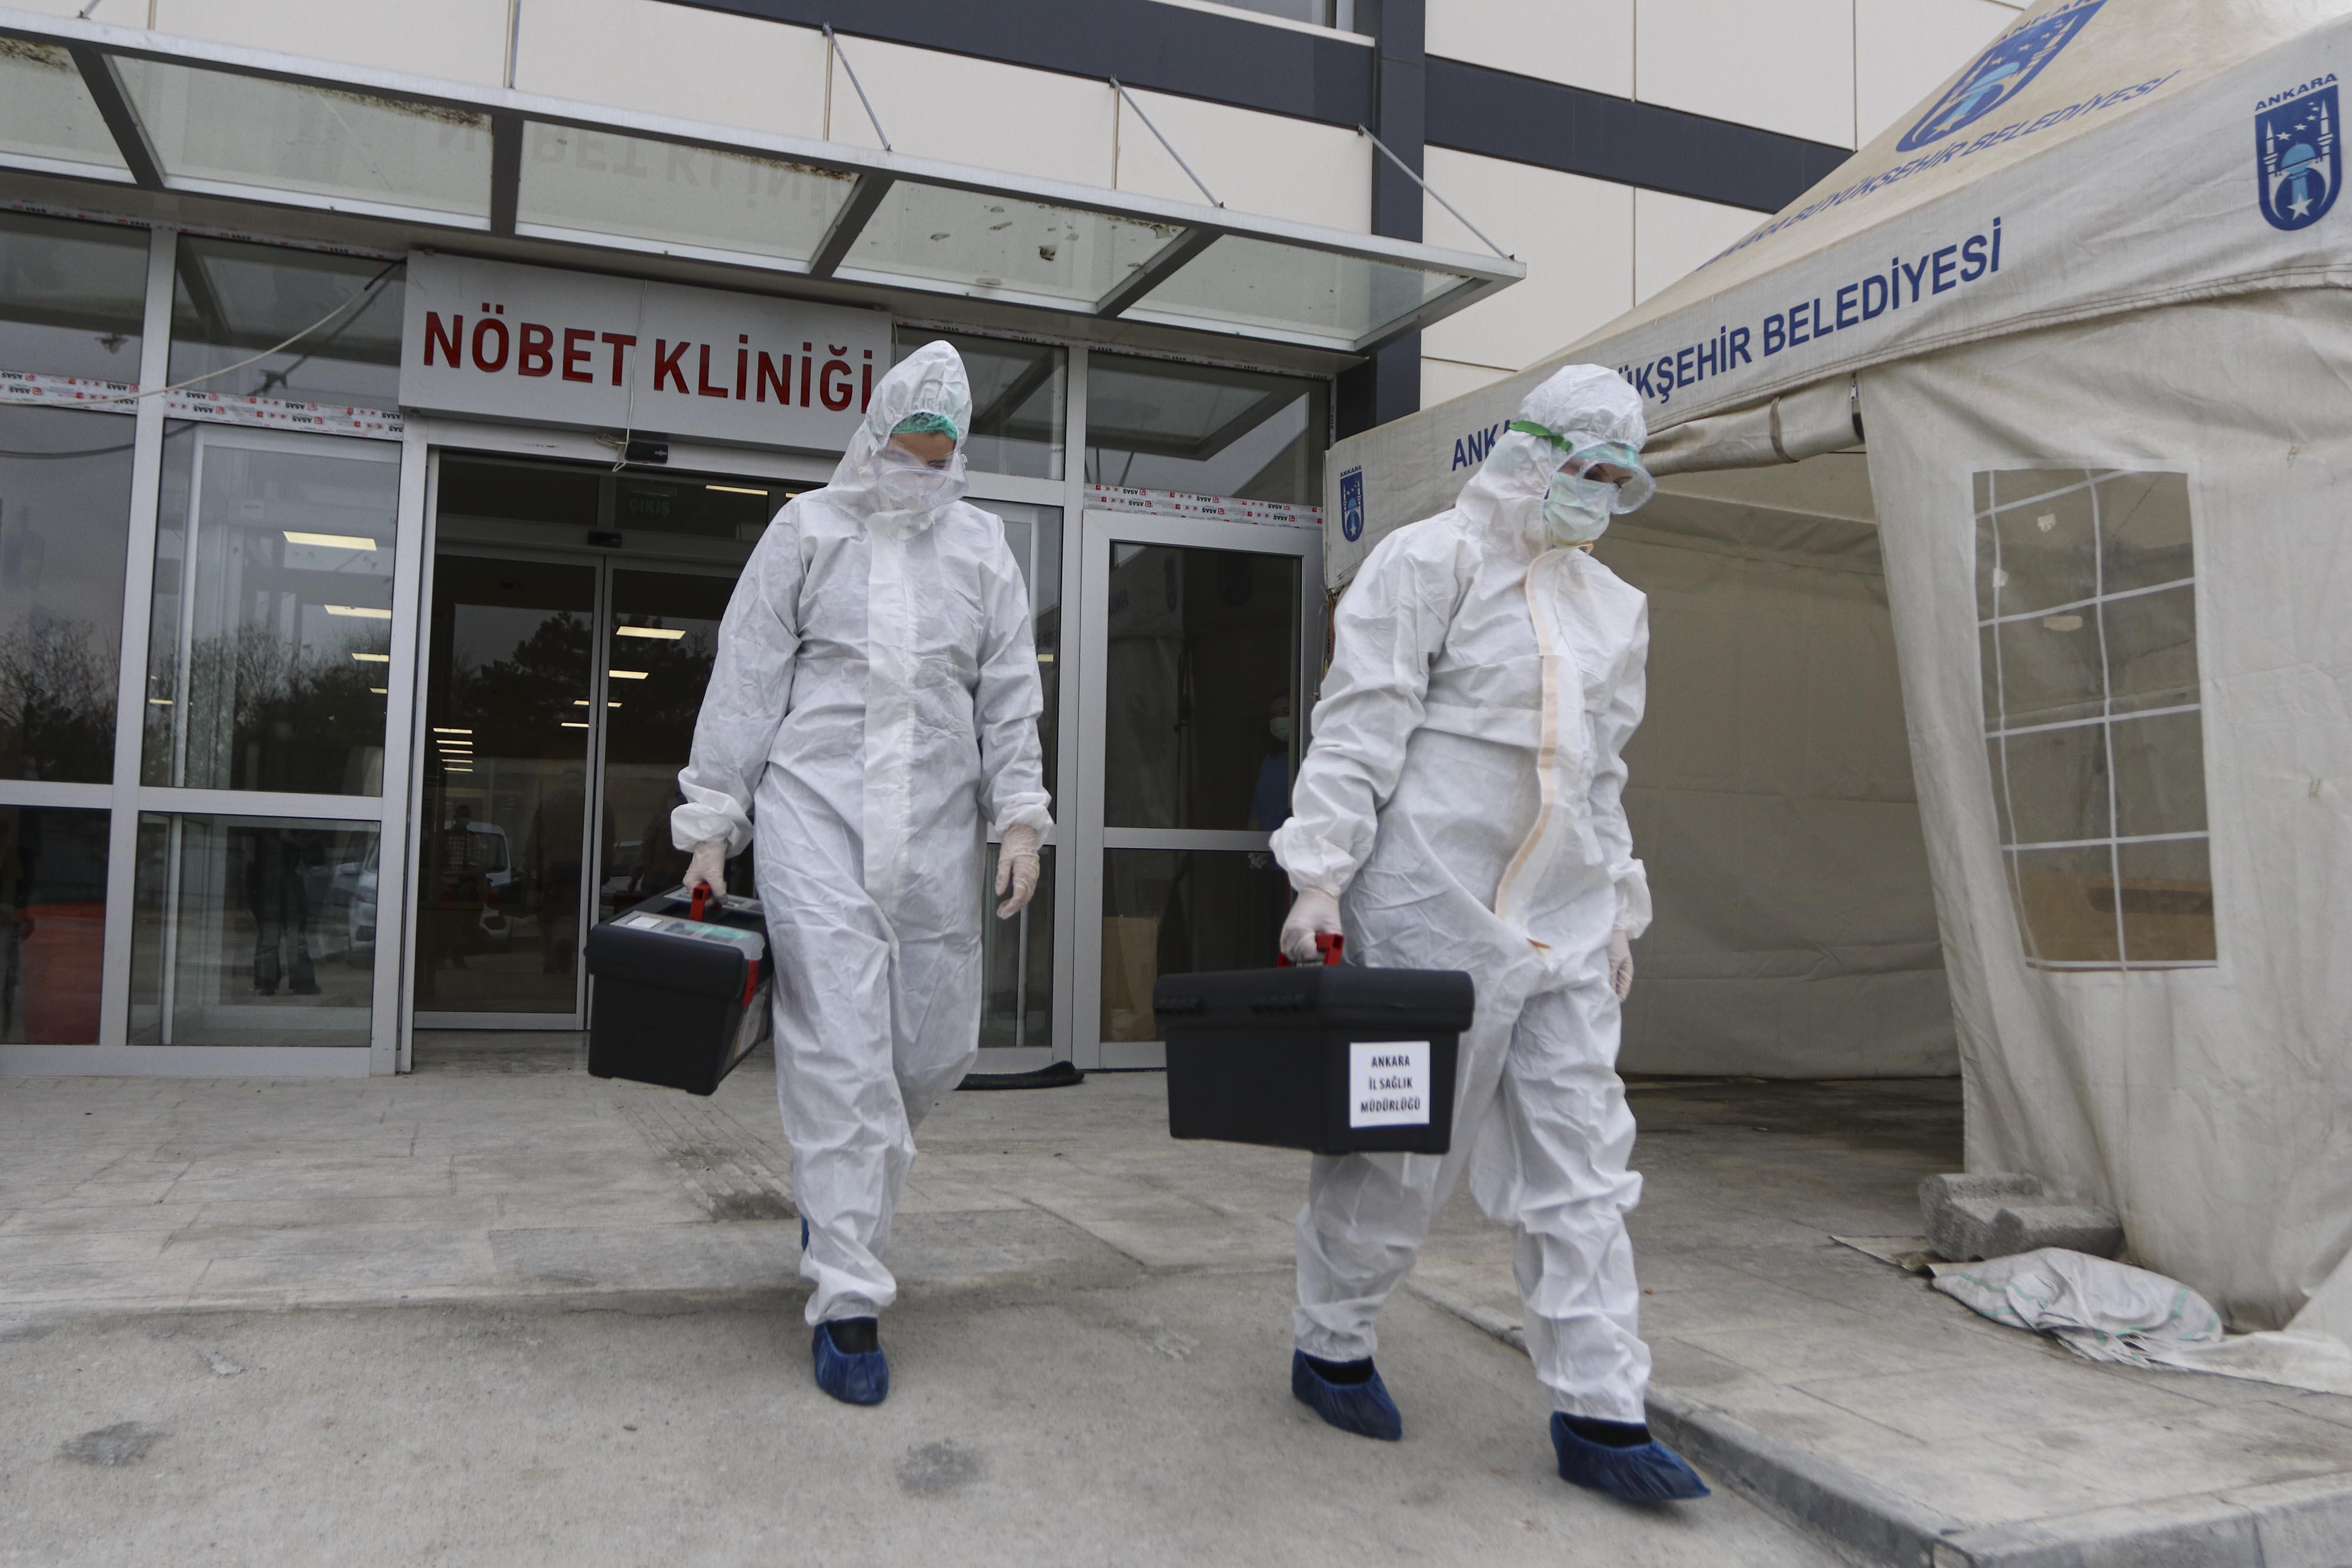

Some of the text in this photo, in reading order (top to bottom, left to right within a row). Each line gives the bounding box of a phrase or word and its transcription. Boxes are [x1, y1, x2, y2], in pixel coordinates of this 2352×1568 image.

[2255, 73, 2337, 111] ANKARA
[1960, 69, 2183, 157] BELEDİYESİ
[1452, 216, 2000, 471] ANK ÜKŞEHİR BELEDİYESİ
[423, 302, 873, 414] NÖBET KLİNİĞİ
[1340, 465, 1362, 477] ANKARA
[1372, 1055, 1411, 1068] ANKARA
[1369, 1075, 1413, 1090] İL SAĞLIK
[1361, 1096, 1421, 1113] MÜDÜRLÜĞÜ
